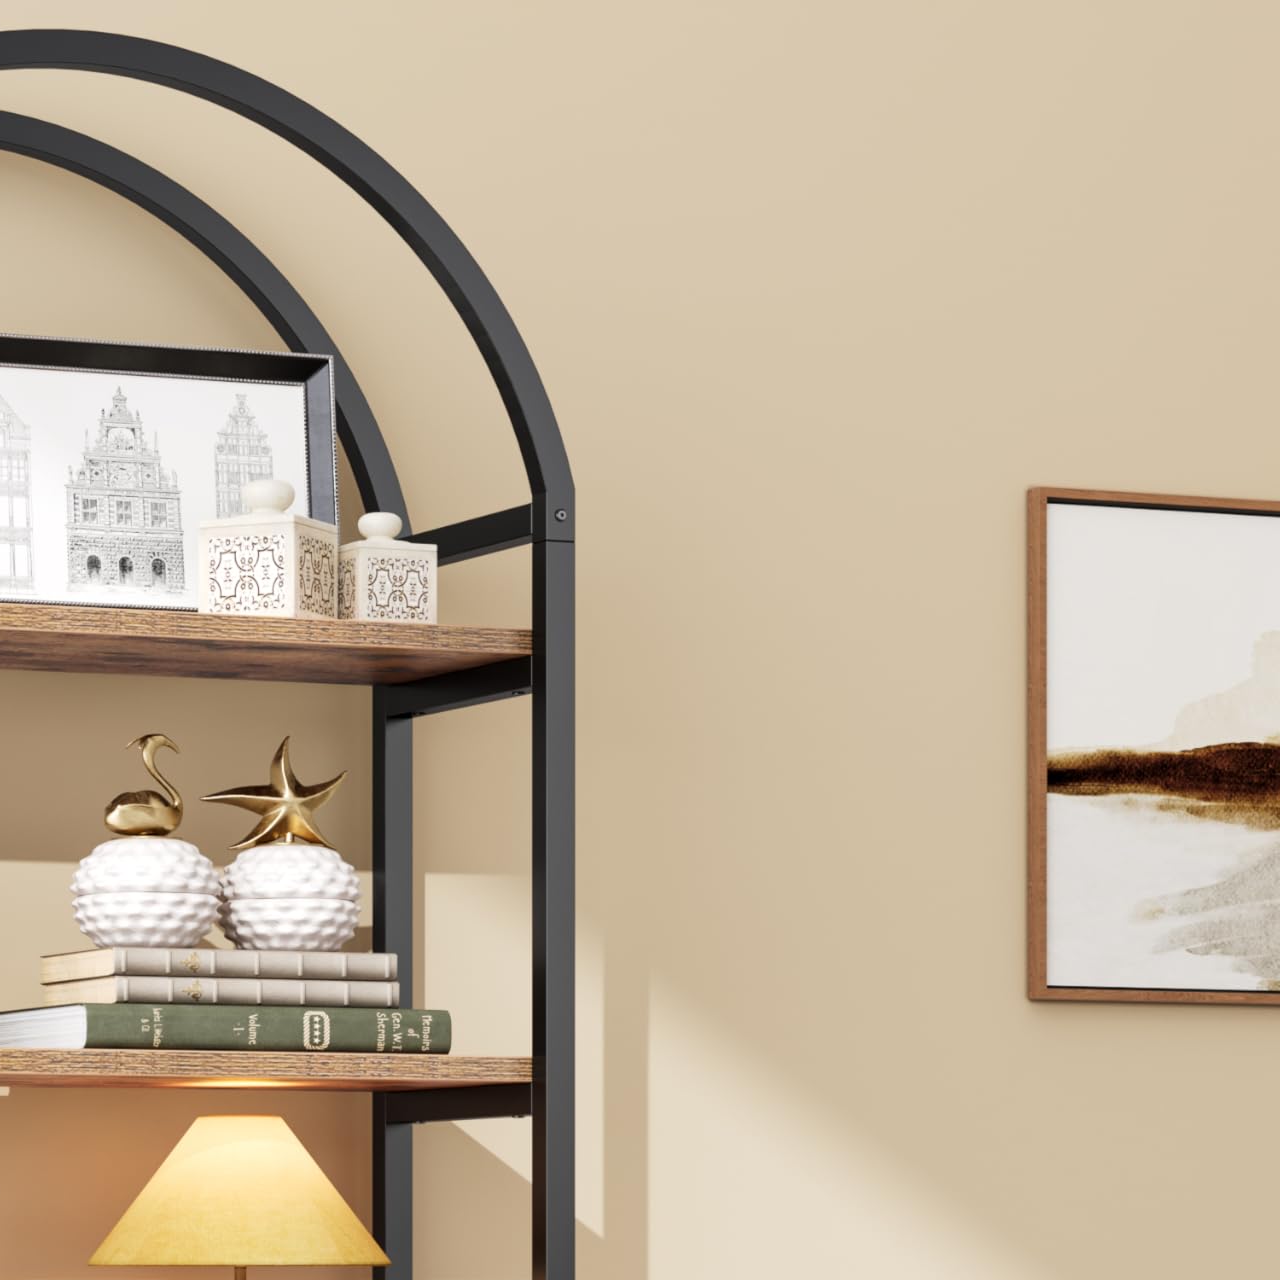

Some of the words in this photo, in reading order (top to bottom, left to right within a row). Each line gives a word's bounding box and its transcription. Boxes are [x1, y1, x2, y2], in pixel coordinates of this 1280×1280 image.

[248, 1013, 261, 1045] Volume
[376, 1012, 389, 1052] Sherman
[407, 1028, 420, 1039] of
[421, 1015, 433, 1051] Memoirs
